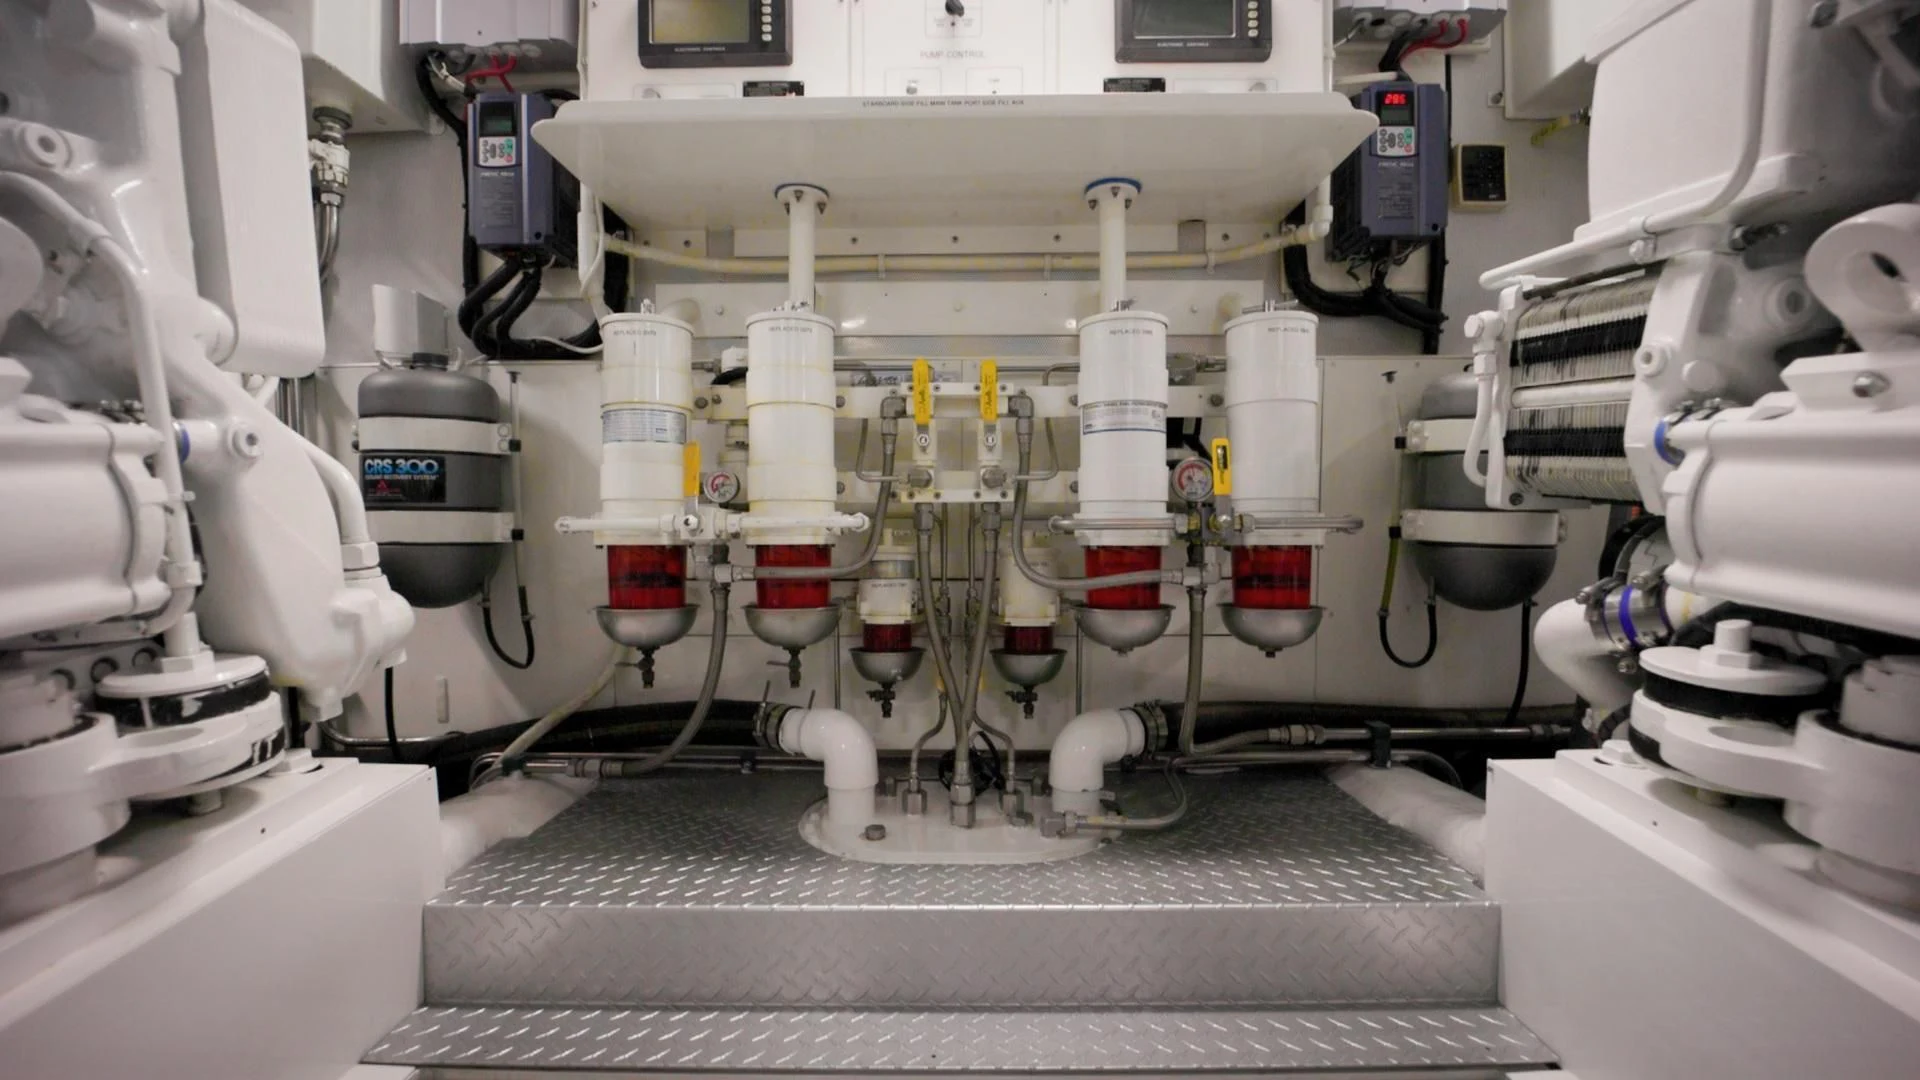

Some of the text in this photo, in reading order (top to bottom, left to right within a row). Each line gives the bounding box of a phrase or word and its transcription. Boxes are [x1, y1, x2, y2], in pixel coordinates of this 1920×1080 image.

[946, 49, 985, 59] CONTROL
[365, 458, 439, 475] CRS 300
